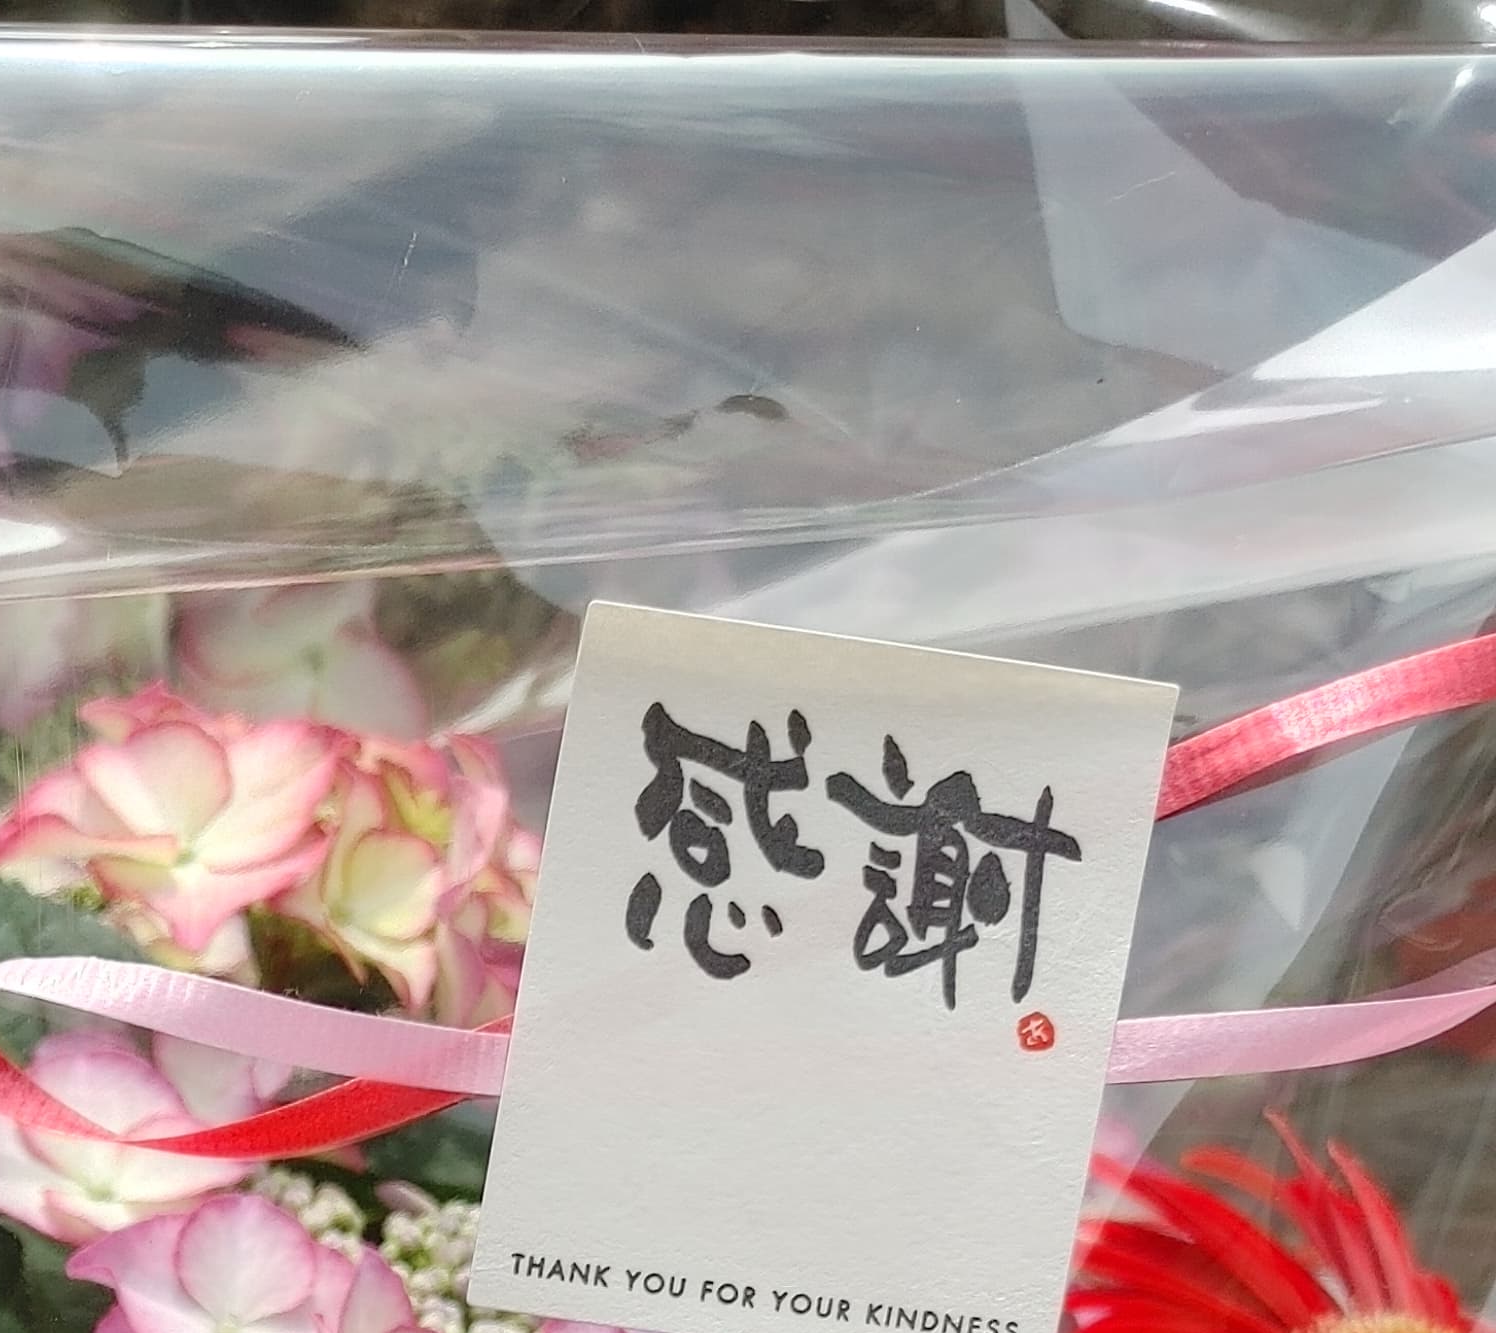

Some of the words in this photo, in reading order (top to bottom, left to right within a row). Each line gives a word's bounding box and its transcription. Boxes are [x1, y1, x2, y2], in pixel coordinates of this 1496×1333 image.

[625, 700, 1082, 1010] 感謝
[510, 1252, 611, 1288] THANK
[625, 1268, 688, 1298] YOU
[699, 1280, 757, 1309] FOR
[771, 1290, 851, 1322] YOUR
